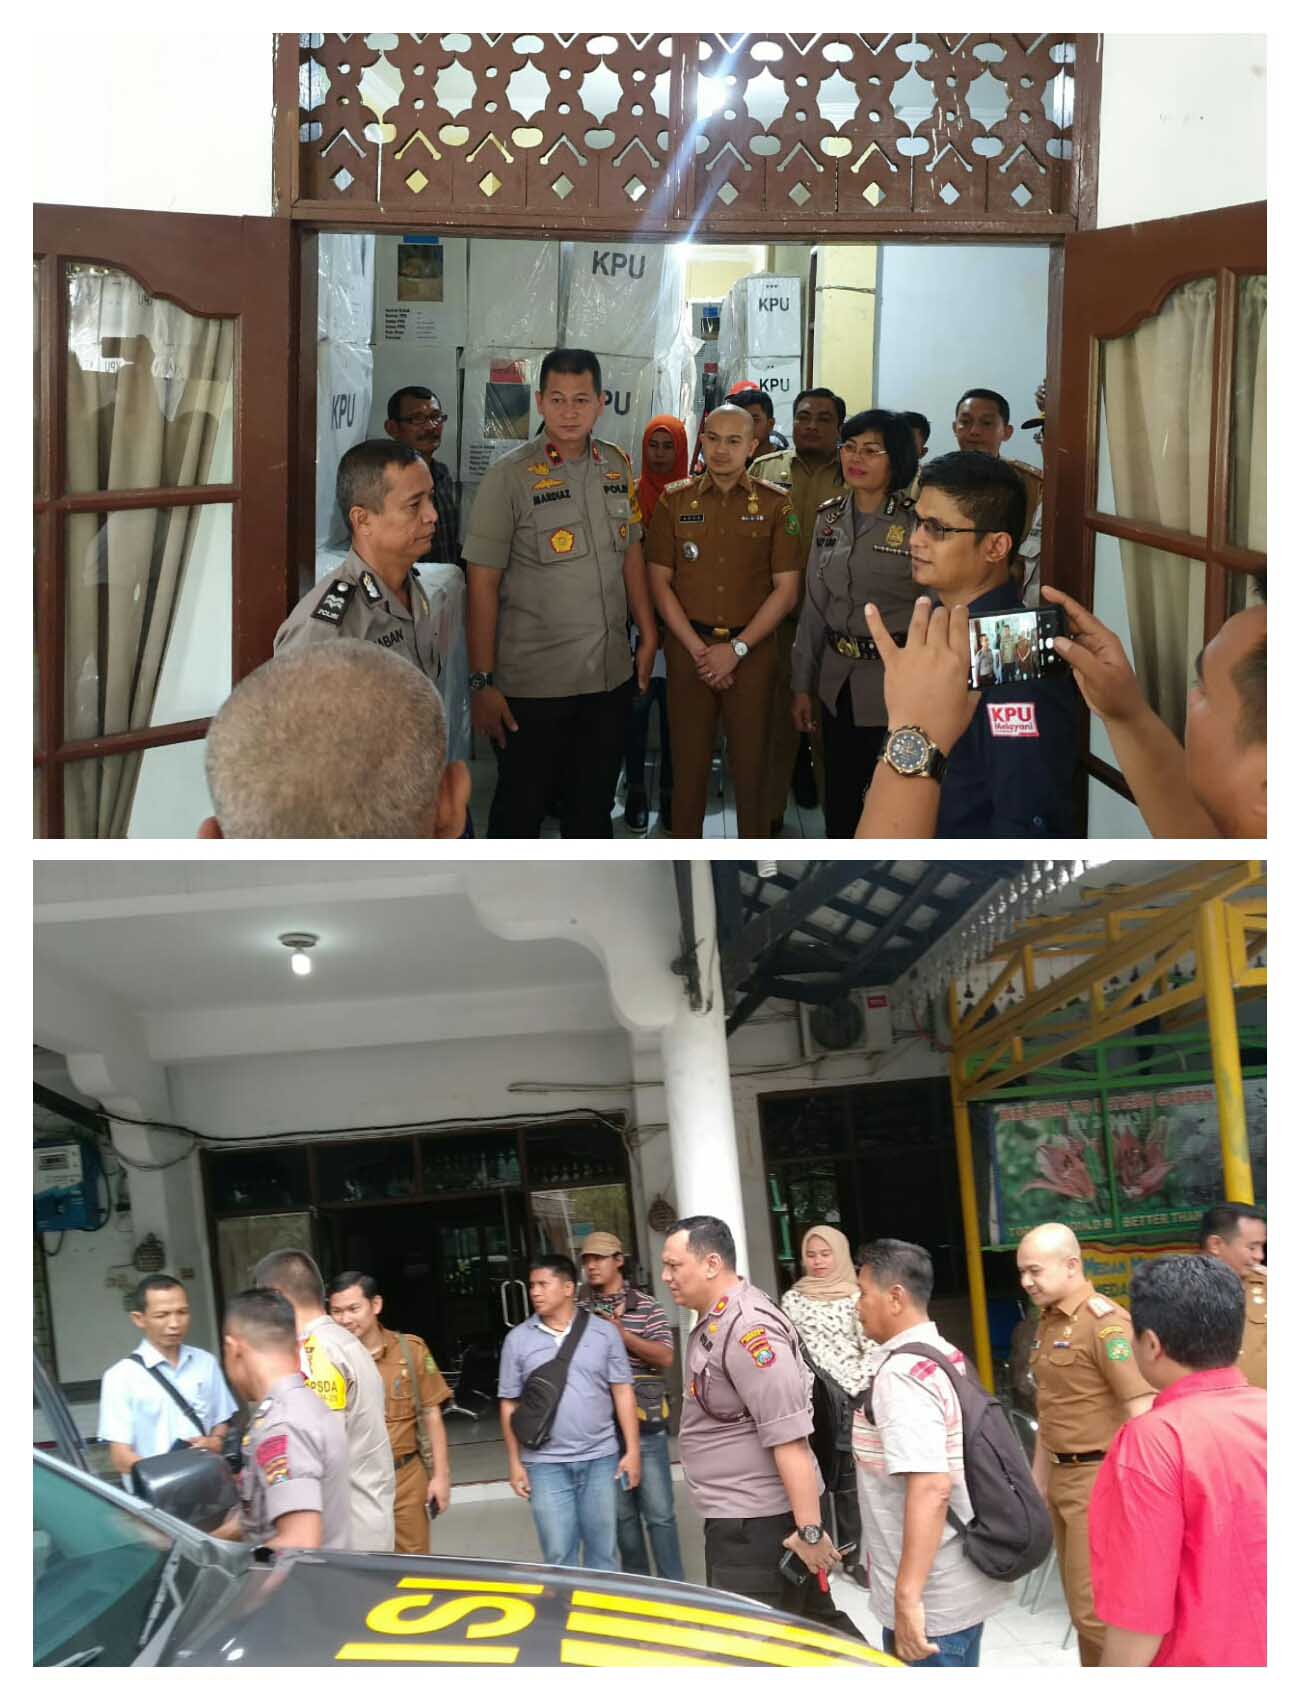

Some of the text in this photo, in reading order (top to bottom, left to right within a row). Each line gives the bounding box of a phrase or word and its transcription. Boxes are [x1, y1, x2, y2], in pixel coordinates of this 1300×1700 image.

[591, 250, 645, 279] KPU
[758, 297, 790, 313] KPU
[759, 378, 791, 393] KPU
[331, 394, 356, 430] KPU
[604, 390, 631, 415] PU
[992, 707, 1032, 721] KPU
[334, 1577, 544, 1662] ISI
